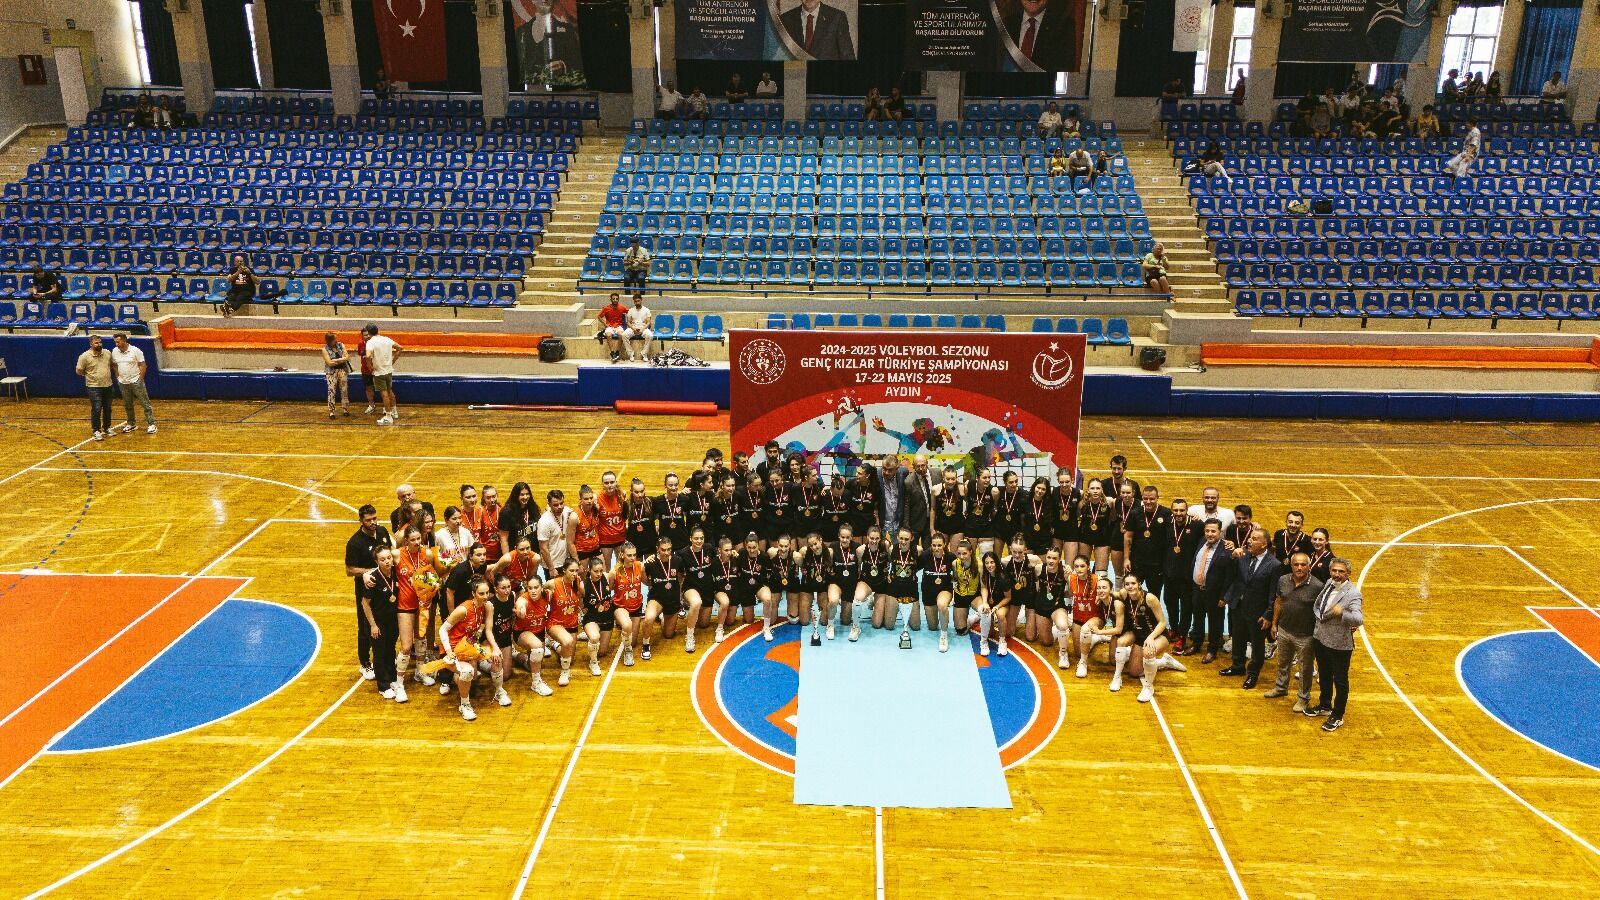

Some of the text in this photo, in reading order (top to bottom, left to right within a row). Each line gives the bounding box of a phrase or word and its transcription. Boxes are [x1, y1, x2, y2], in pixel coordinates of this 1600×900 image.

[921, 12, 979, 20] TÜM ANTRENÖR
[915, 29, 949, 37] BAŞARILAR
[820, 344, 990, 357] 2024-2025 VOLEYBOL SEZONU
[800, 357, 1009, 373] GENÇ KIZLAR TÜRKİYE ŞAMPİYONASI
[855, 373, 952, 384] 17-22 MAYIS 2025
[884, 387, 921, 397] AYDIN
[606, 516, 620, 526] 30
